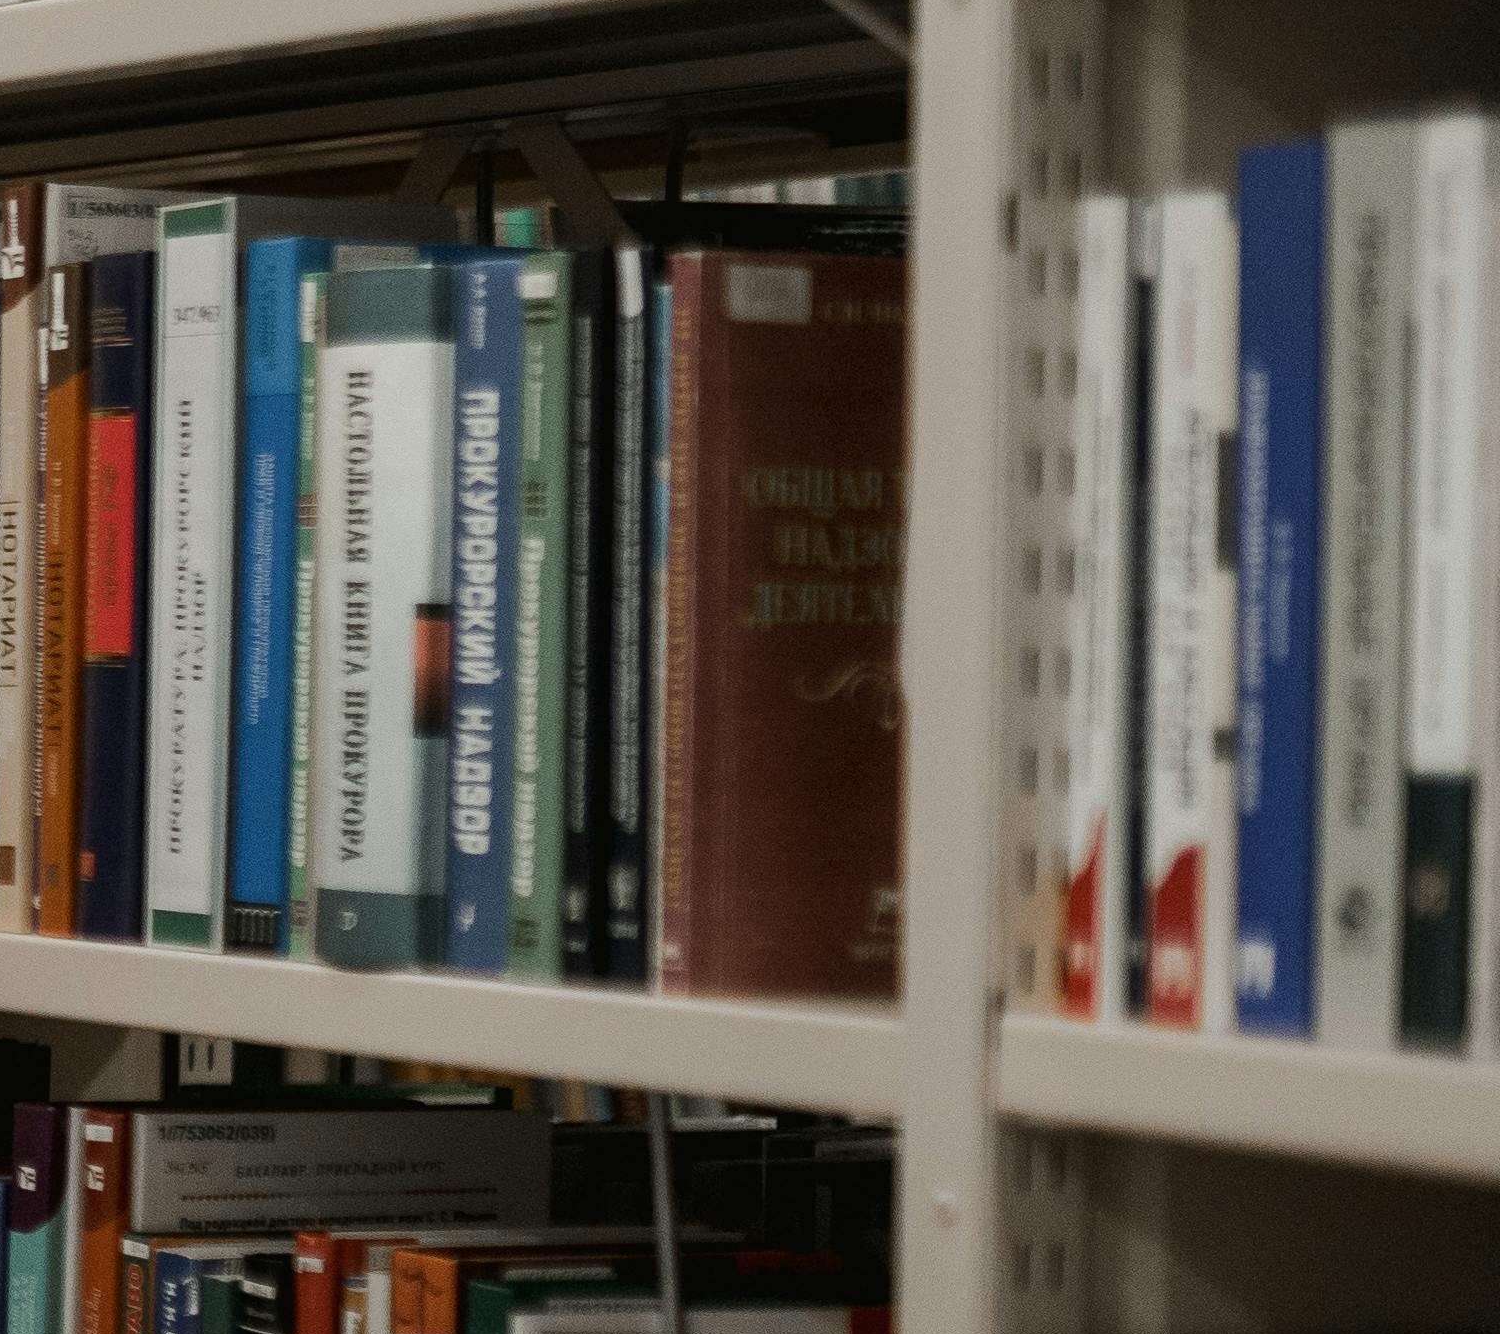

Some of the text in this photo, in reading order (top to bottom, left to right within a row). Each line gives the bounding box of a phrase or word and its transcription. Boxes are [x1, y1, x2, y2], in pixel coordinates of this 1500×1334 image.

[1, 511, 18, 678] НОТАРИАТ
[174, 399, 193, 632] ПРОКУРОРСКИЙ
[339, 369, 374, 863] НАСТОЛЬНАЯ КНИГА ПРОКУРОРА
[46, 561, 65, 734] НОТАРИАТ
[192, 572, 208, 682] НАДЗОР
[451, 387, 502, 856] ПРОКУРОРСКИЙ НАДЗОР
